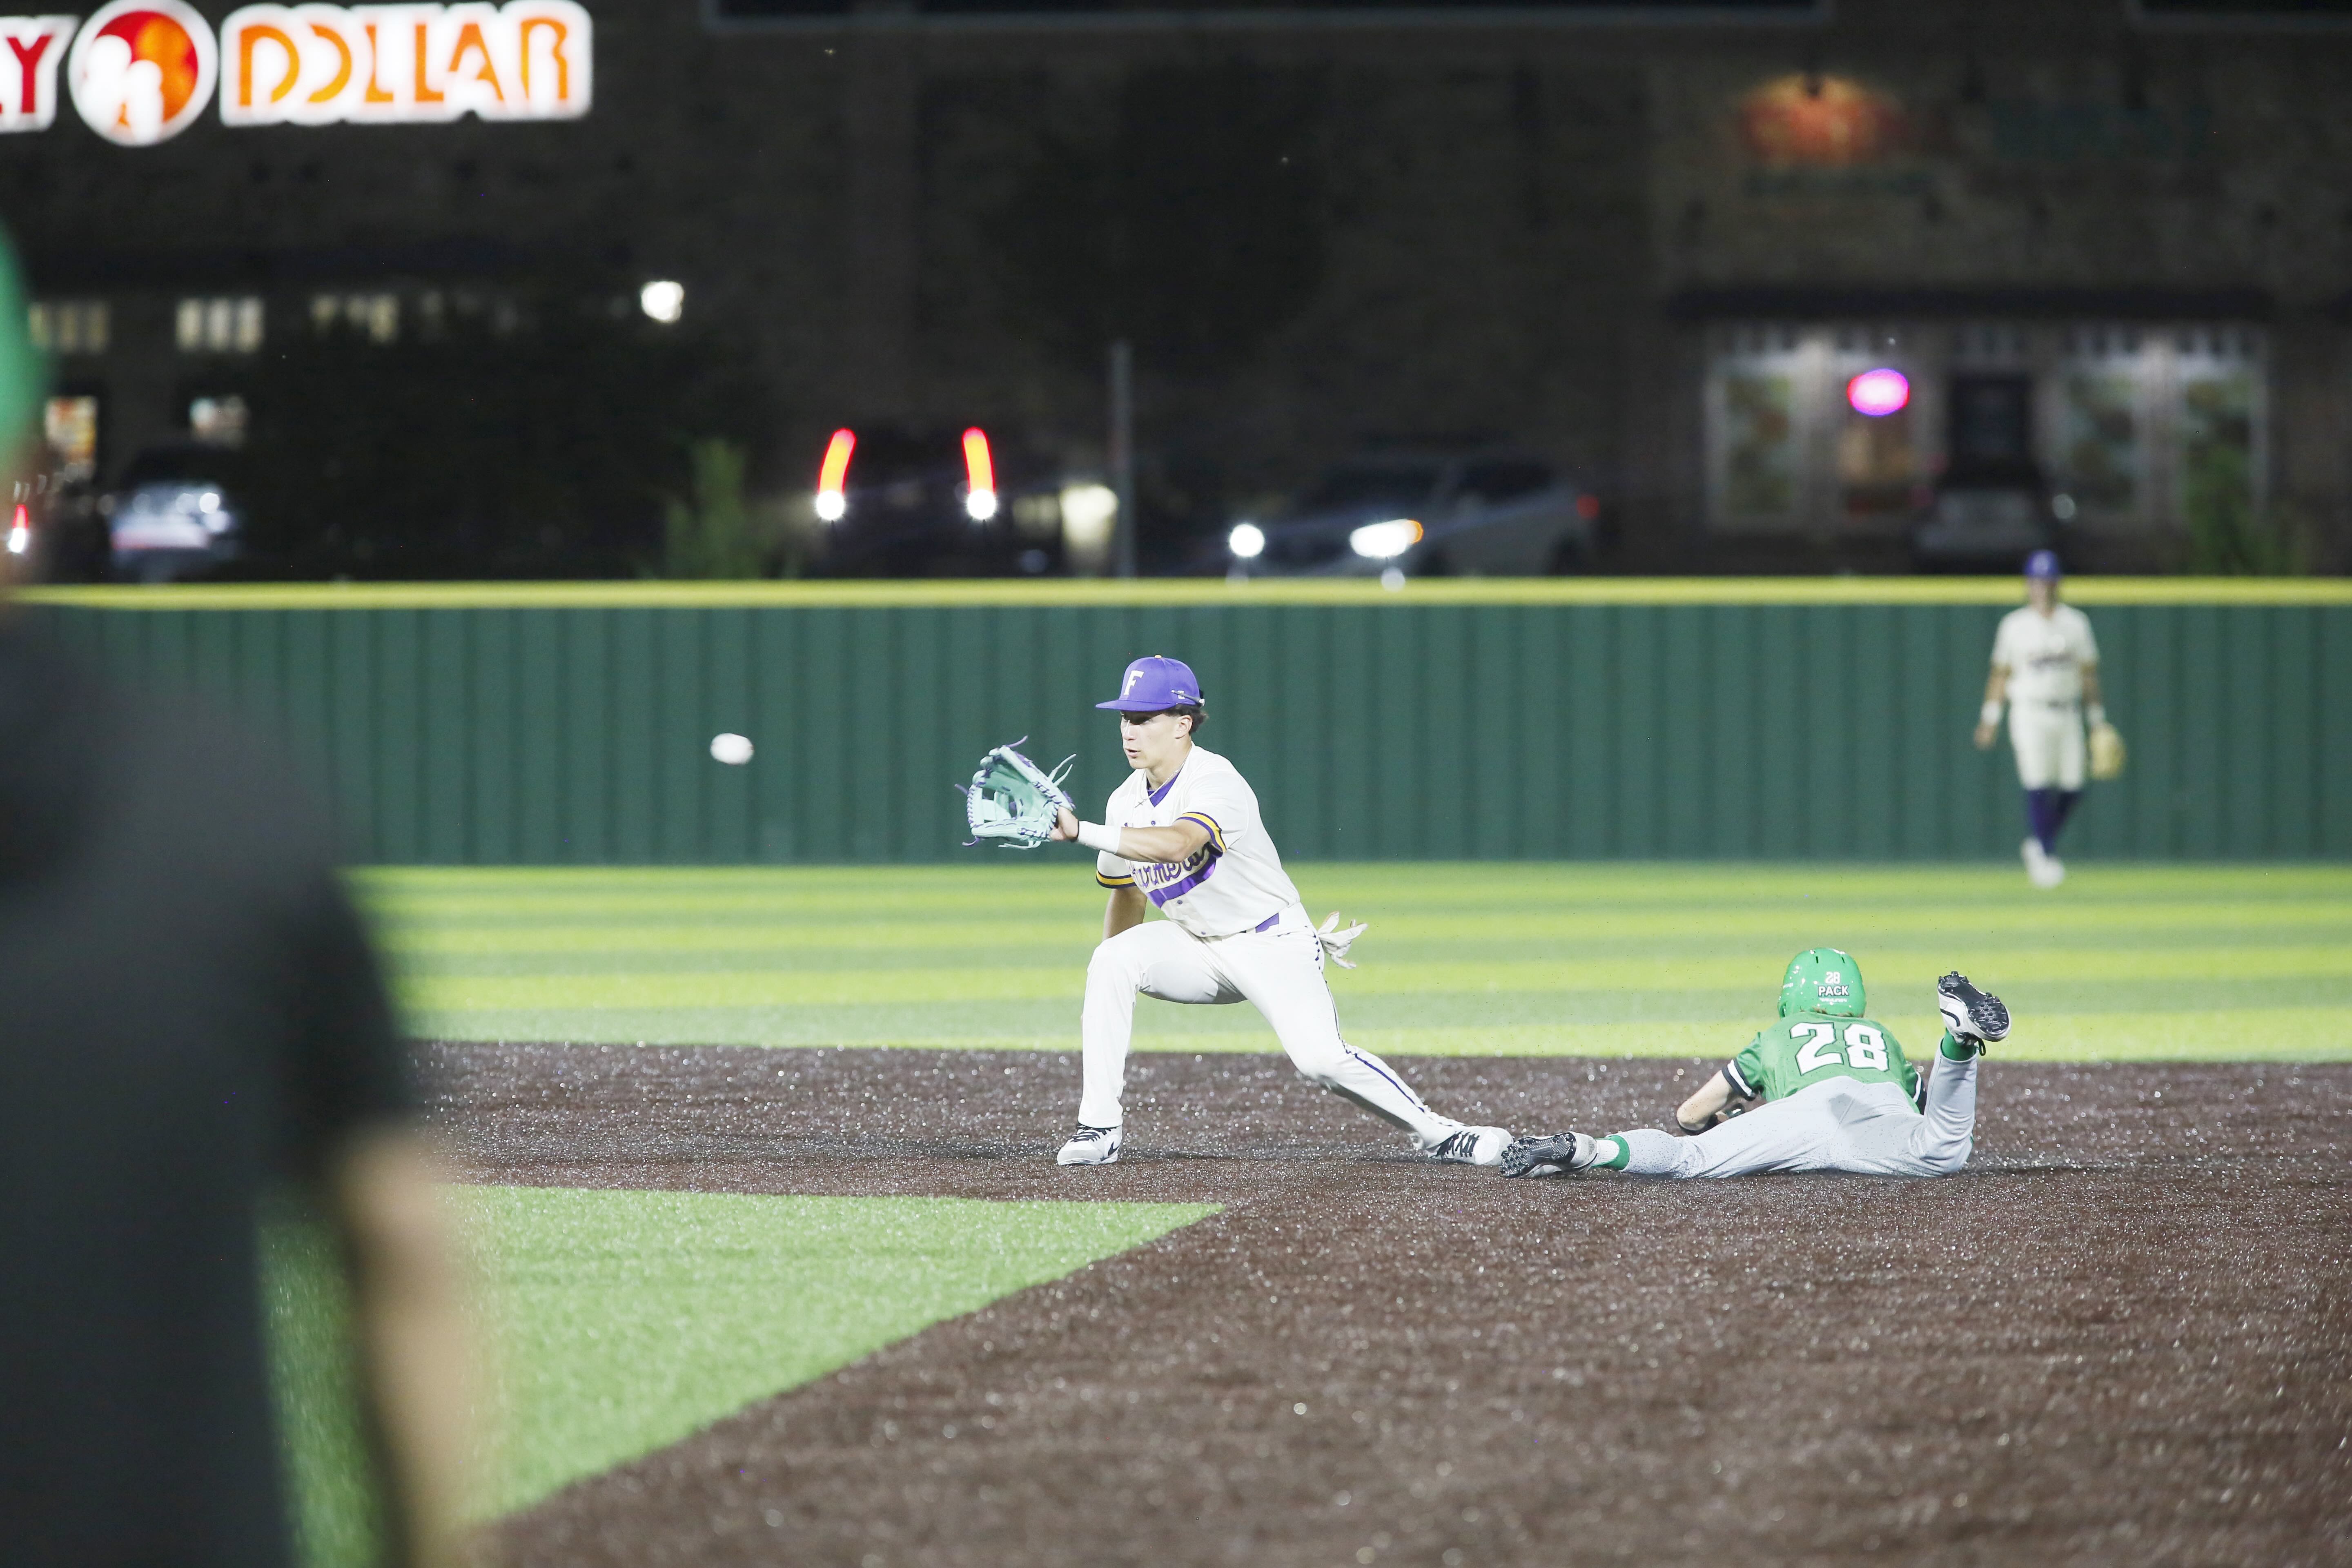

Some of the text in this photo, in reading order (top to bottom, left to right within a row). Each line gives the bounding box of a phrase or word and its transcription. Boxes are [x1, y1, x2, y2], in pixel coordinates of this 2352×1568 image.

[0, 7, 585, 125] Y DOLLAR
[1123, 670, 1144, 696] F
[1818, 985, 1849, 997] PACK
[1825, 971, 1841, 985] 28
[1789, 1022, 1890, 1076] 28
